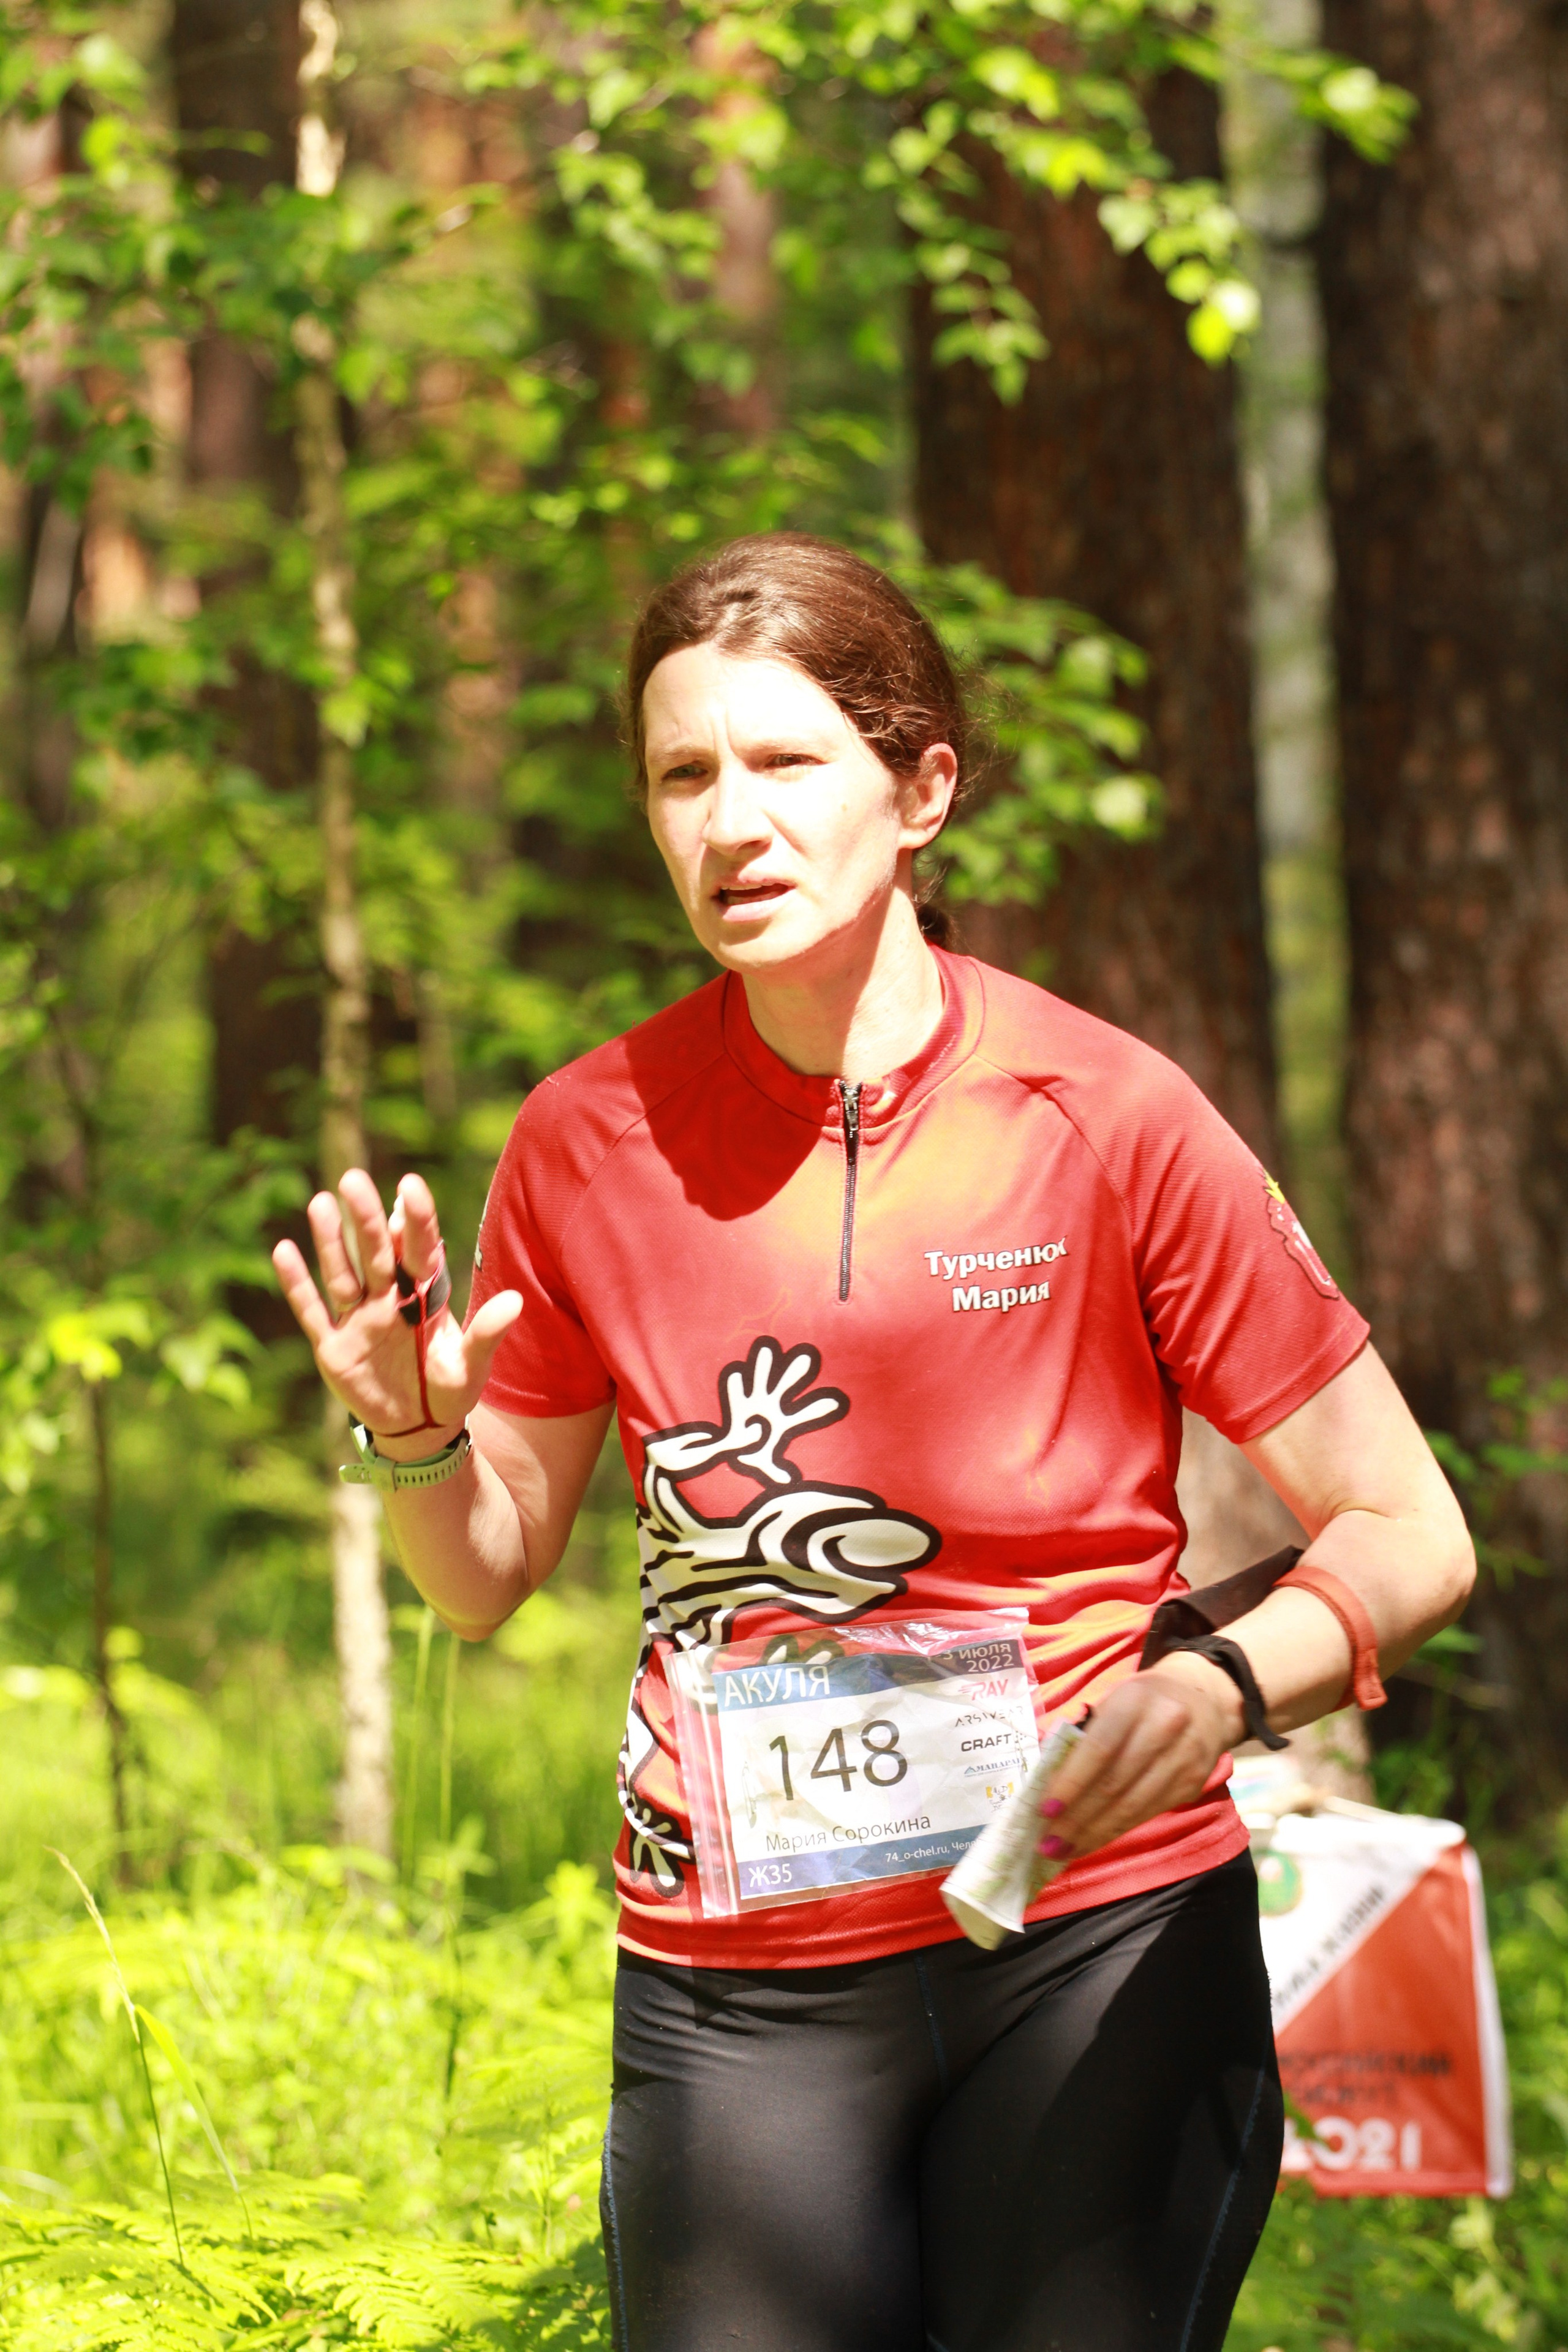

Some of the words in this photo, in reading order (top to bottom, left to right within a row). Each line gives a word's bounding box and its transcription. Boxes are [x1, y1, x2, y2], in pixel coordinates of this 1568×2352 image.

[952, 1281, 1051, 1313] Мария
[959, 1643, 1011, 1660] ИЮЛЯ
[967, 1654, 1014, 1673] 2022
[724, 1665, 831, 1707] АКУЛЯ
[961, 1733, 1012, 1752] CRAFT
[769, 1719, 908, 1801] 148
[766, 1832, 827, 1853] Мария
[832, 1815, 931, 1844] Сорокина
[748, 1863, 792, 1888] Ж35
